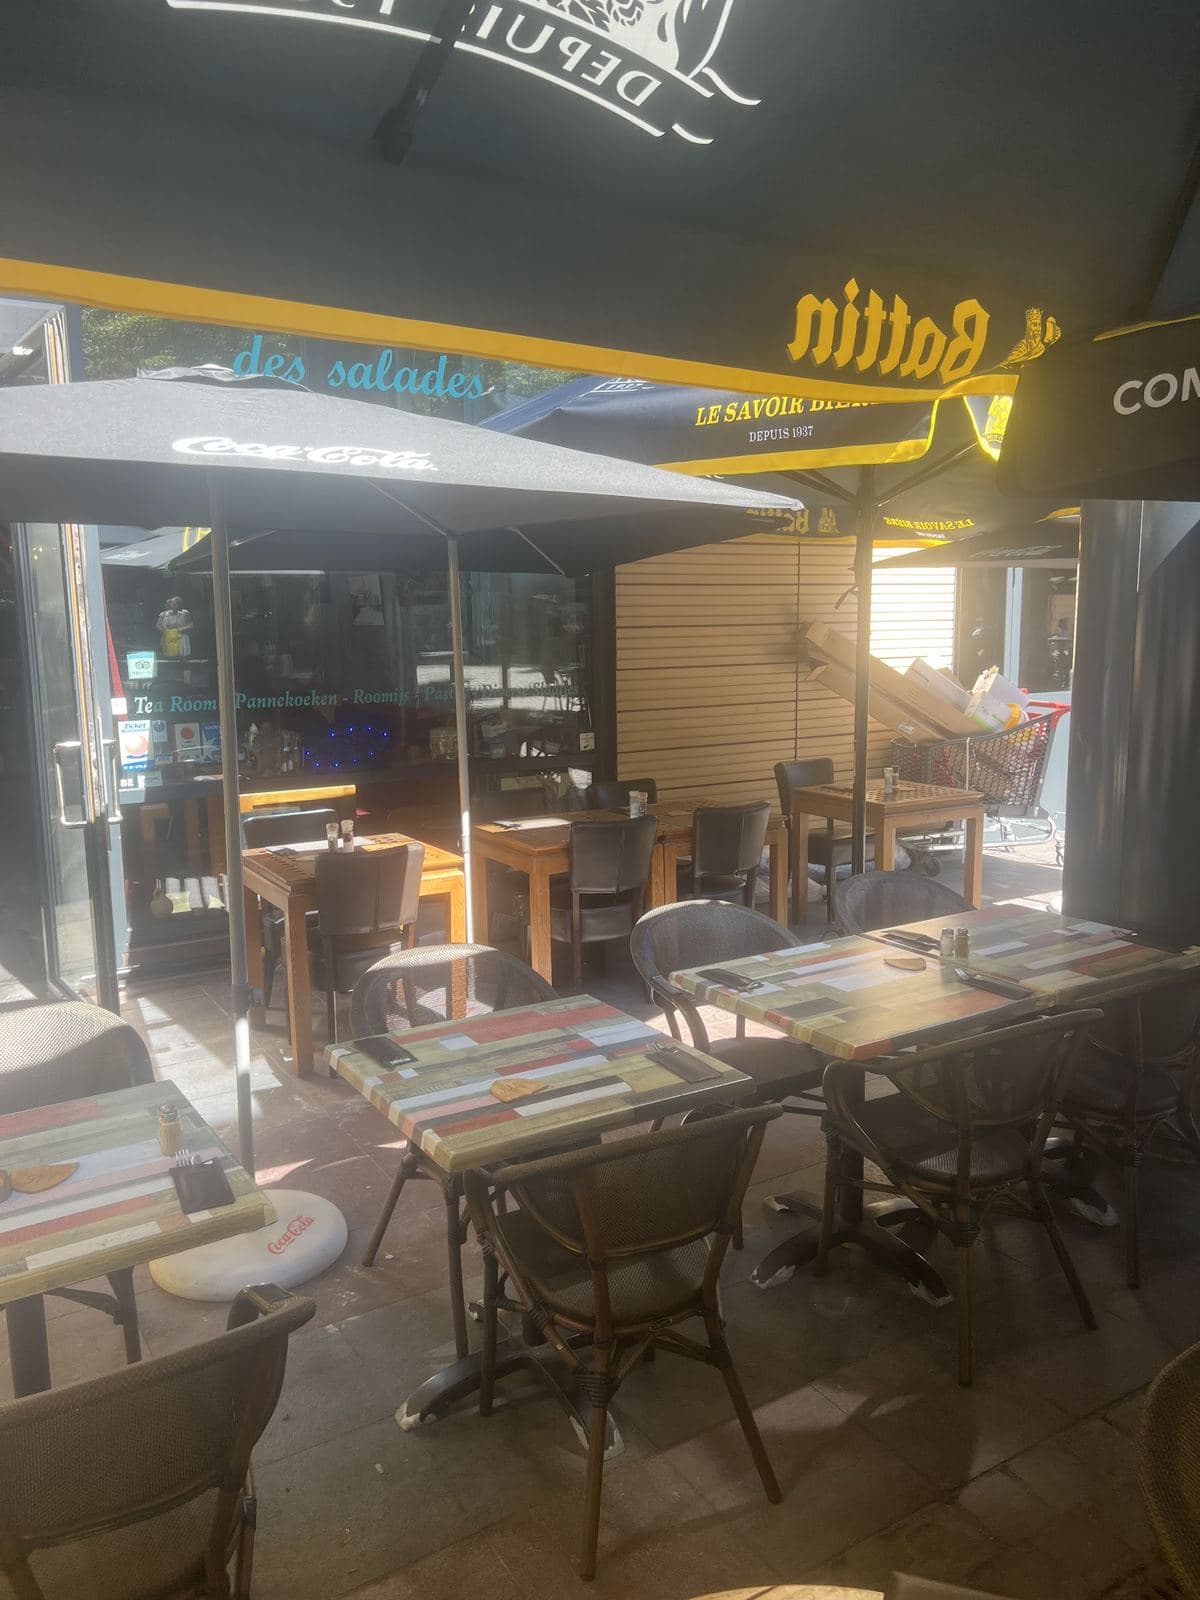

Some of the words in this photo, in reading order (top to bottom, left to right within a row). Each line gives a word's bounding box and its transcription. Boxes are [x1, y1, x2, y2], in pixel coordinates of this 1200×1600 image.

[232, 335, 305, 383] des
[328, 349, 483, 399] salades
[695, 405, 722, 426] LE
[724, 396, 804, 422] SAVOIR
[749, 428, 790, 442] DEPUIS
[792, 425, 814, 438] 1937
[134, 696, 164, 714] Tea
[170, 695, 218, 713] Room
[235, 689, 337, 709] Pannekoeken
[353, 688, 410, 706] Roomijs
[267, 1213, 317, 1255] Coca-Cola
